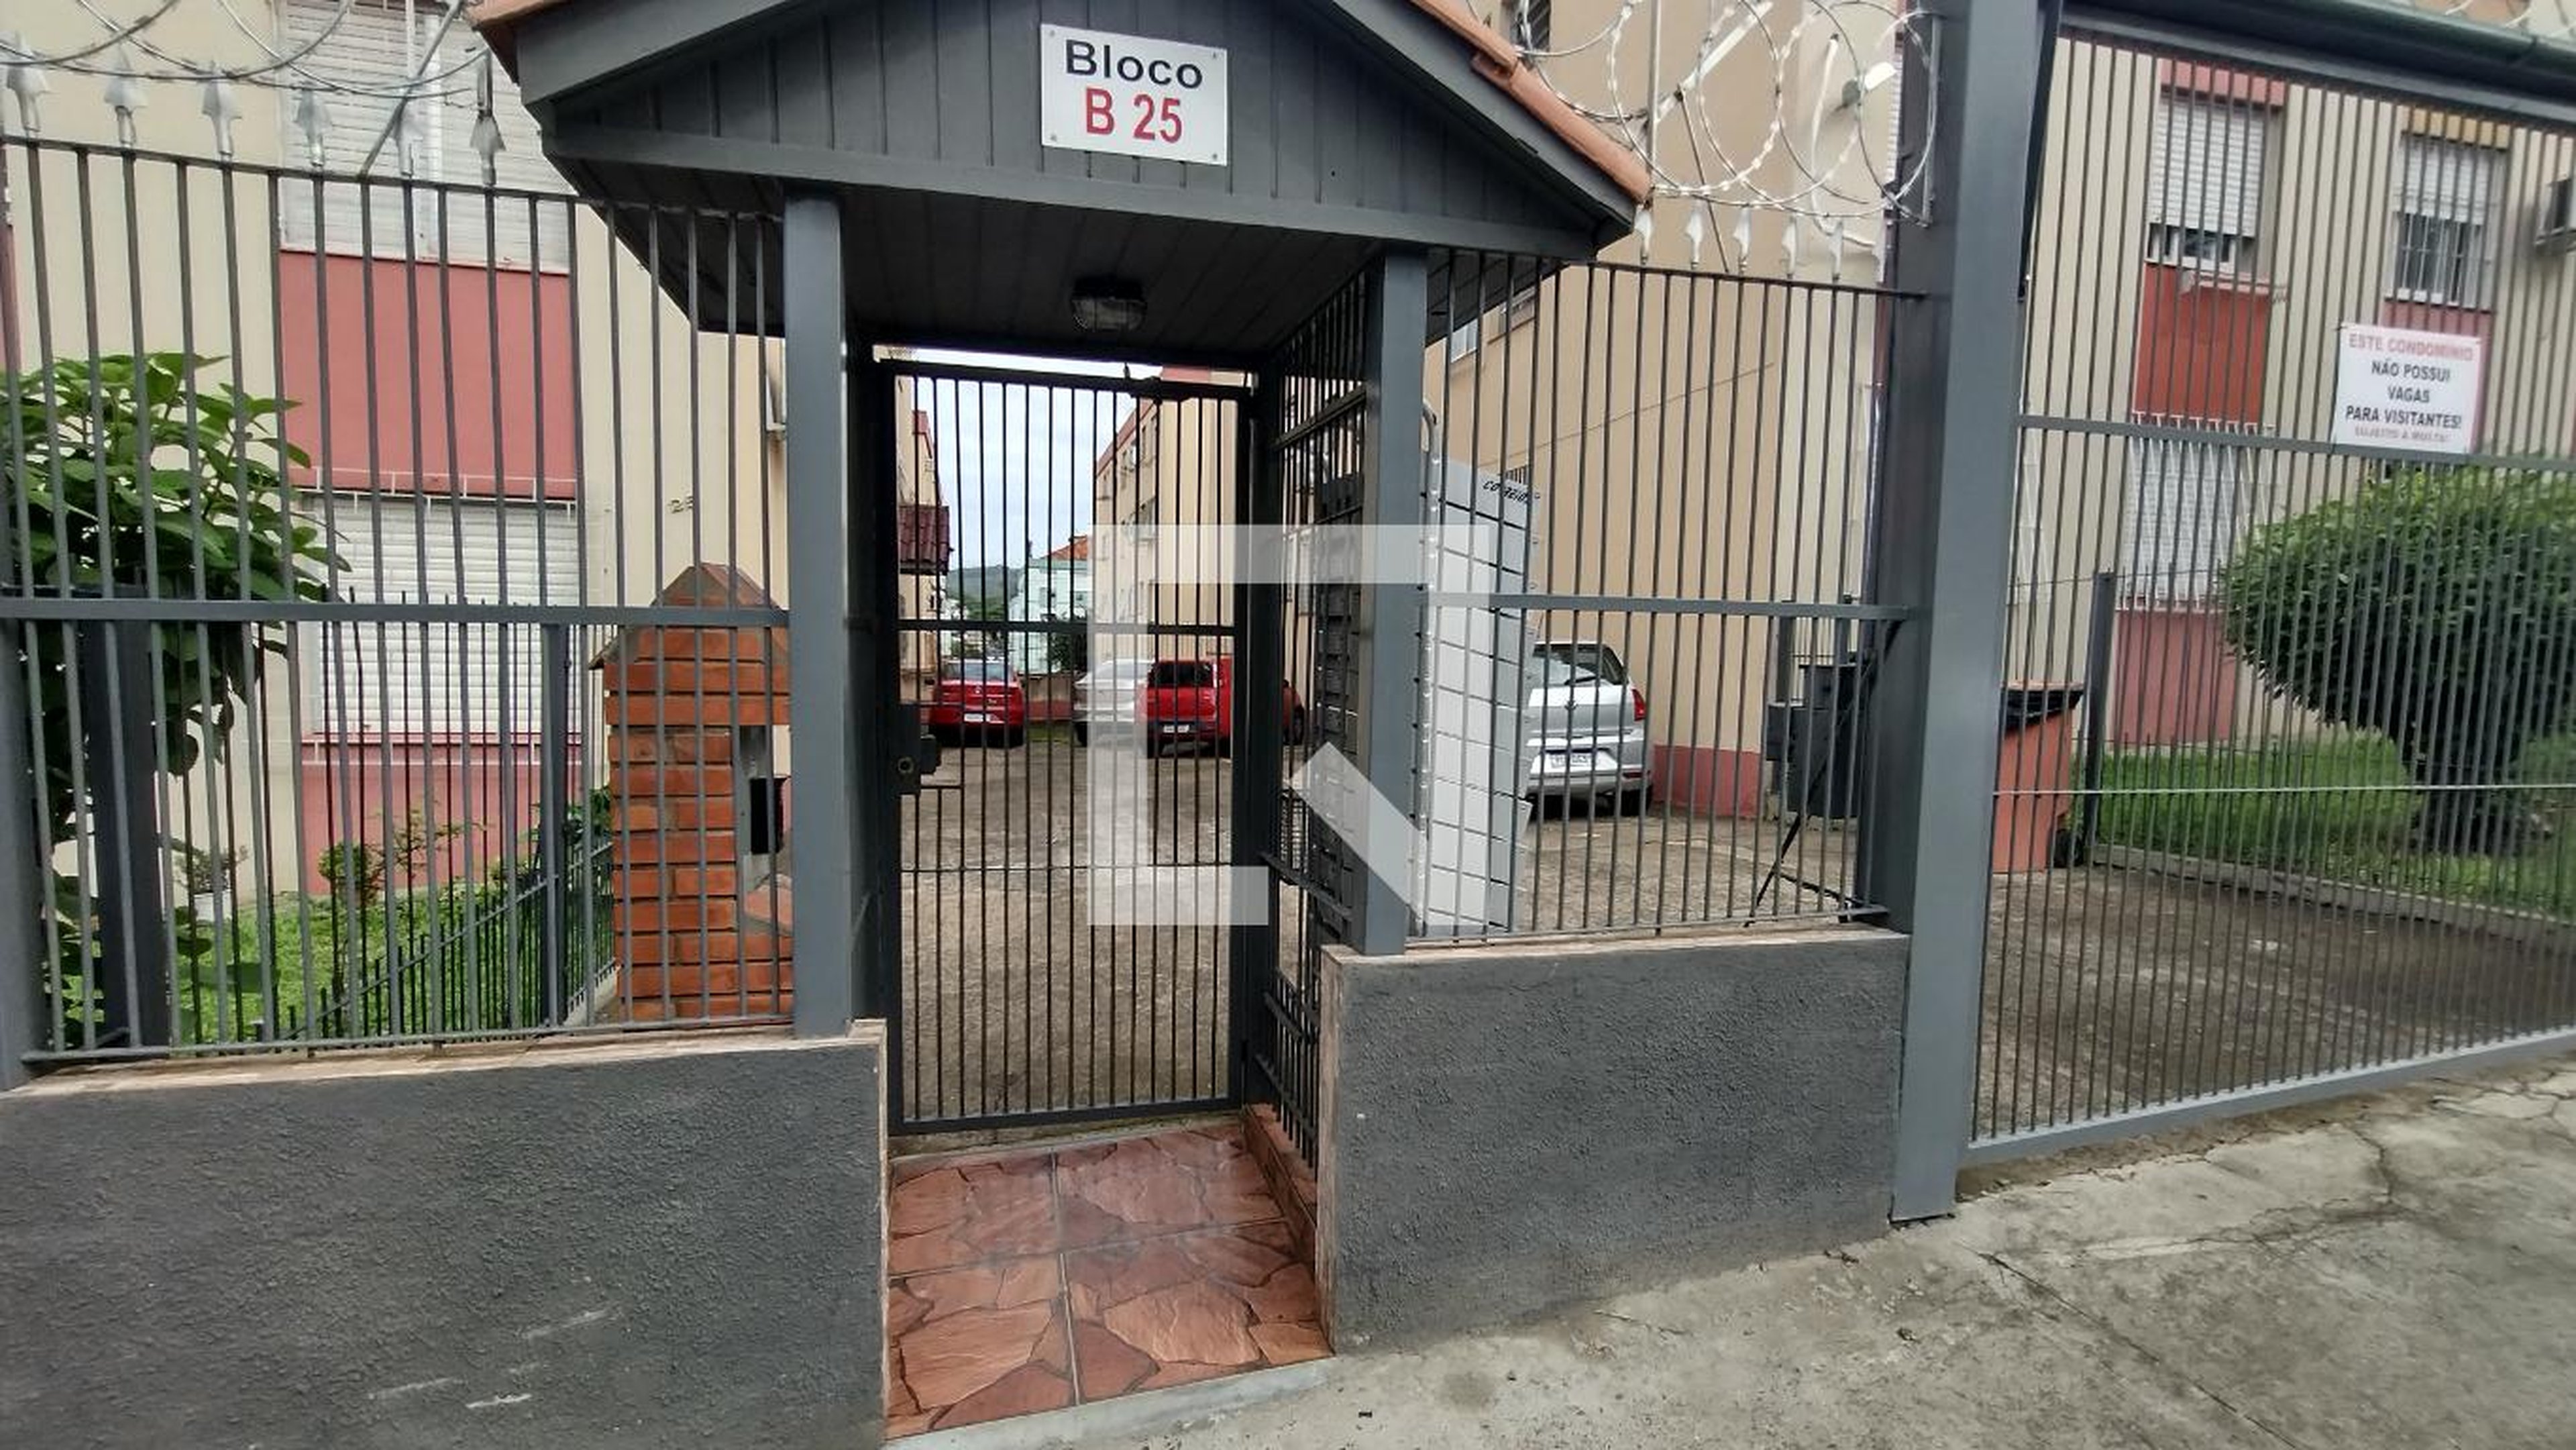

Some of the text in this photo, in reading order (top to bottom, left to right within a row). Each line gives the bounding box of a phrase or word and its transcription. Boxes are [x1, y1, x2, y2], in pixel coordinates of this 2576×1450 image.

[1066, 39, 1203, 89] Bloco
[1086, 88, 1183, 144] B 25
[2349, 333, 2382, 350] ESTE
[2371, 358, 2450, 382] NÃO POSSUI
[2387, 386, 2430, 403] VAGAS
[2346, 405, 2379, 422] PARA
